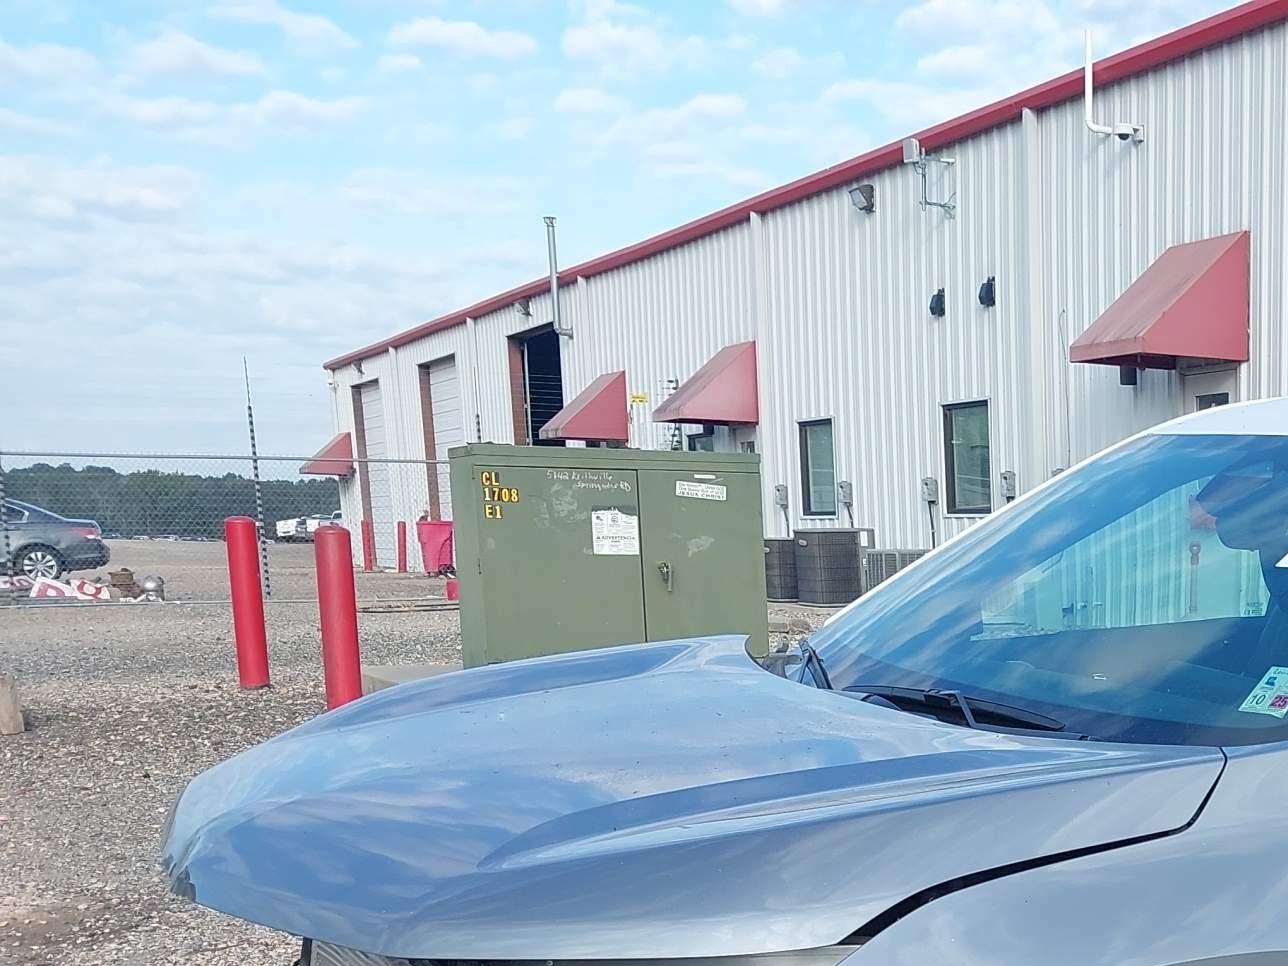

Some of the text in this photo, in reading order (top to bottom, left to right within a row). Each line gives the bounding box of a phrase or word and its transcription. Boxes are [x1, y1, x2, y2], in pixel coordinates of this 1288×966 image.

[482, 471, 500, 486] CL
[484, 487, 519, 502] 1708
[485, 504, 502, 519] E1
[1249, 694, 1266, 705] 10
